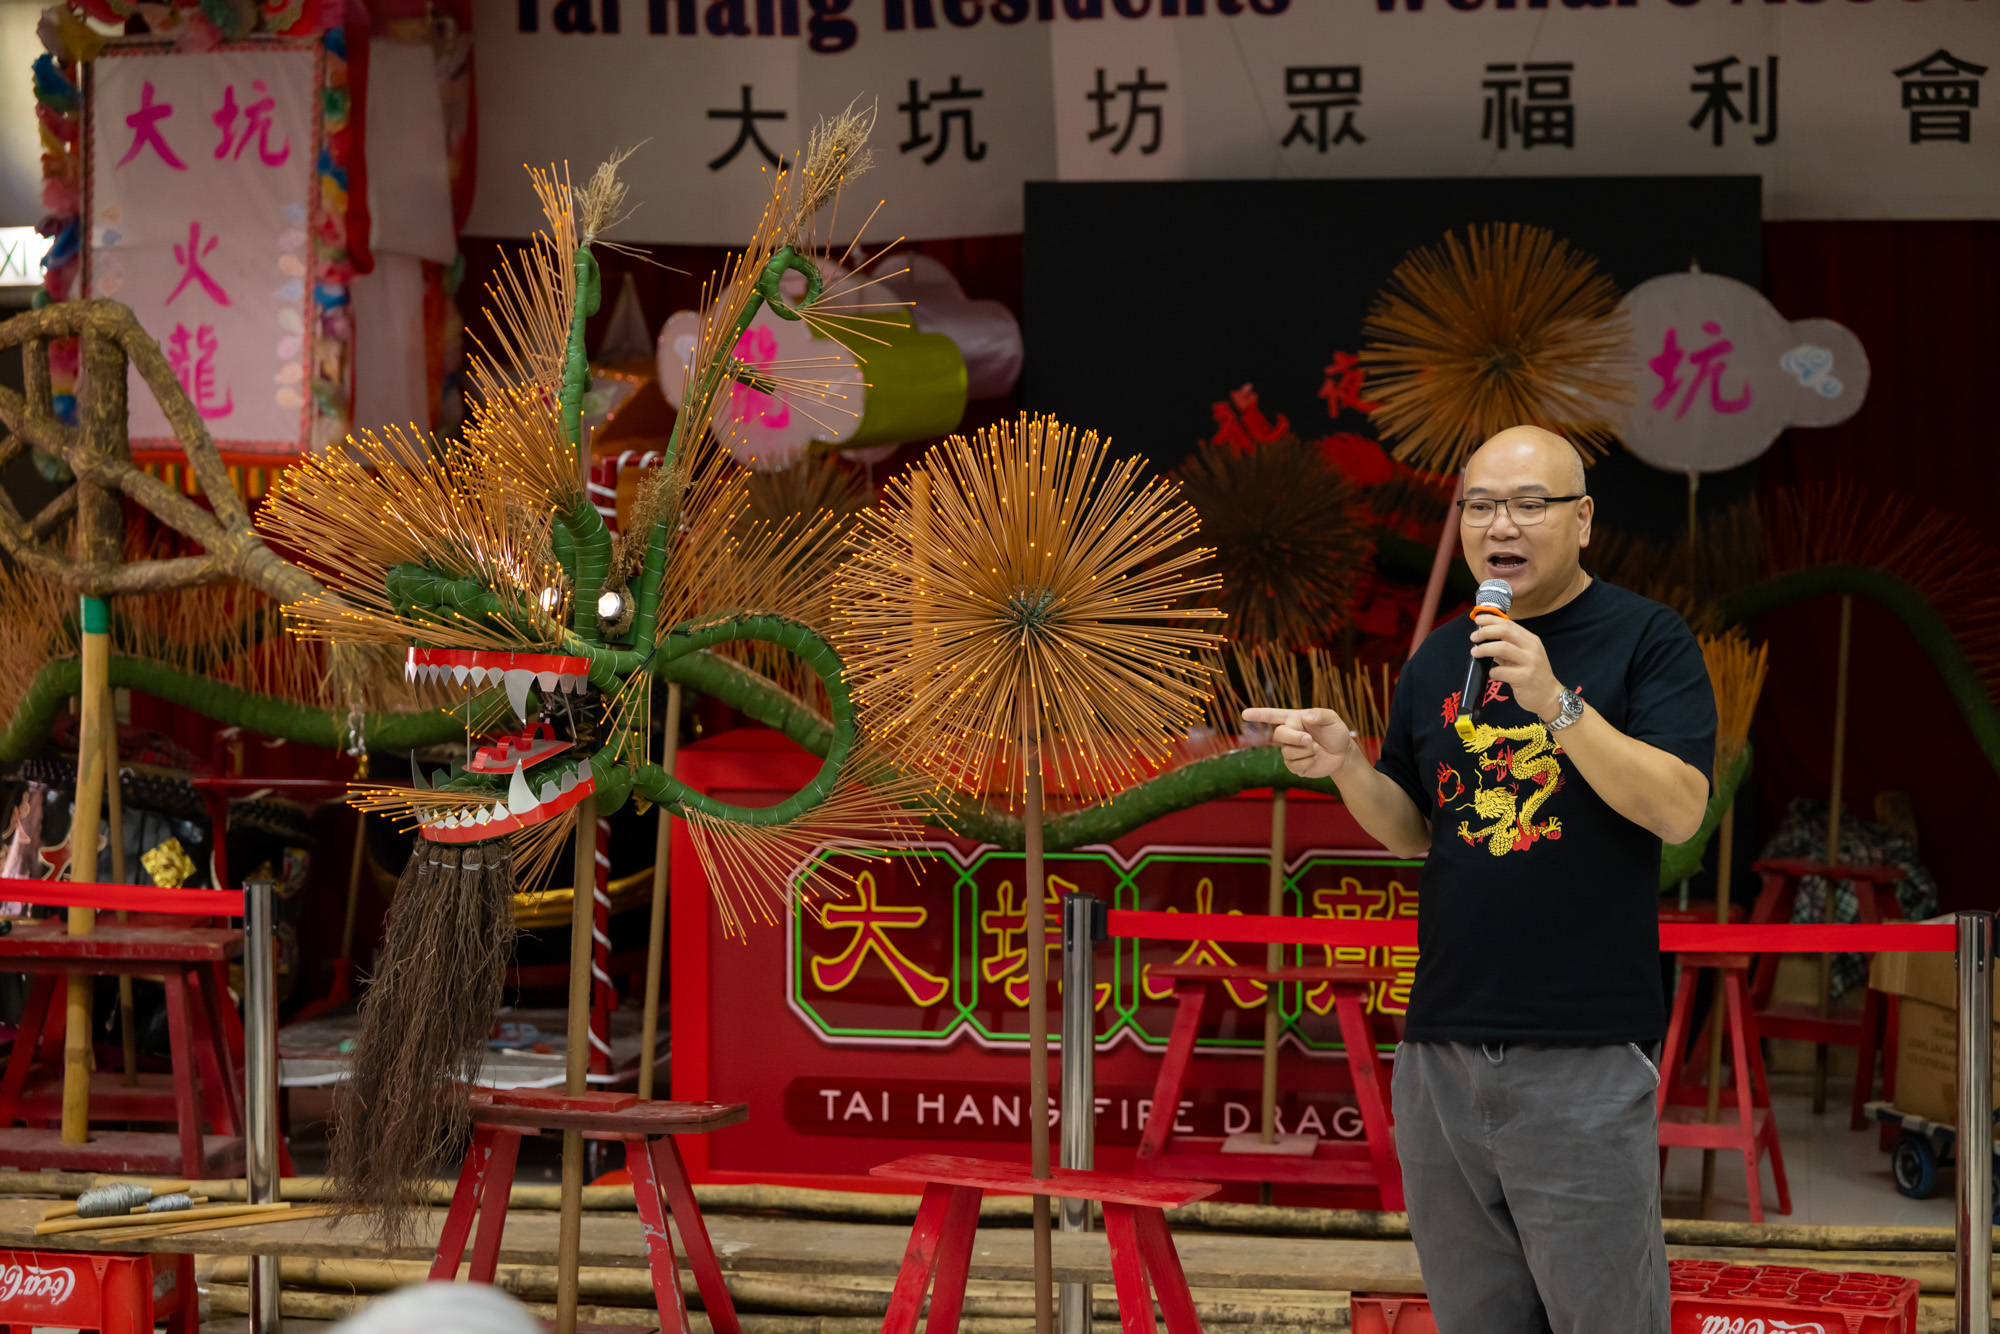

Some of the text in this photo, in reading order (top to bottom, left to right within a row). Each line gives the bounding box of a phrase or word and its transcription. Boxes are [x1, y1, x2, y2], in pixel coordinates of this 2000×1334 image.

[116, 80, 291, 172] 大坑
[708, 48, 1989, 173] 大坑坊眾福利會
[1647, 320, 1752, 421] 坑
[819, 1089, 889, 1122] TAI
